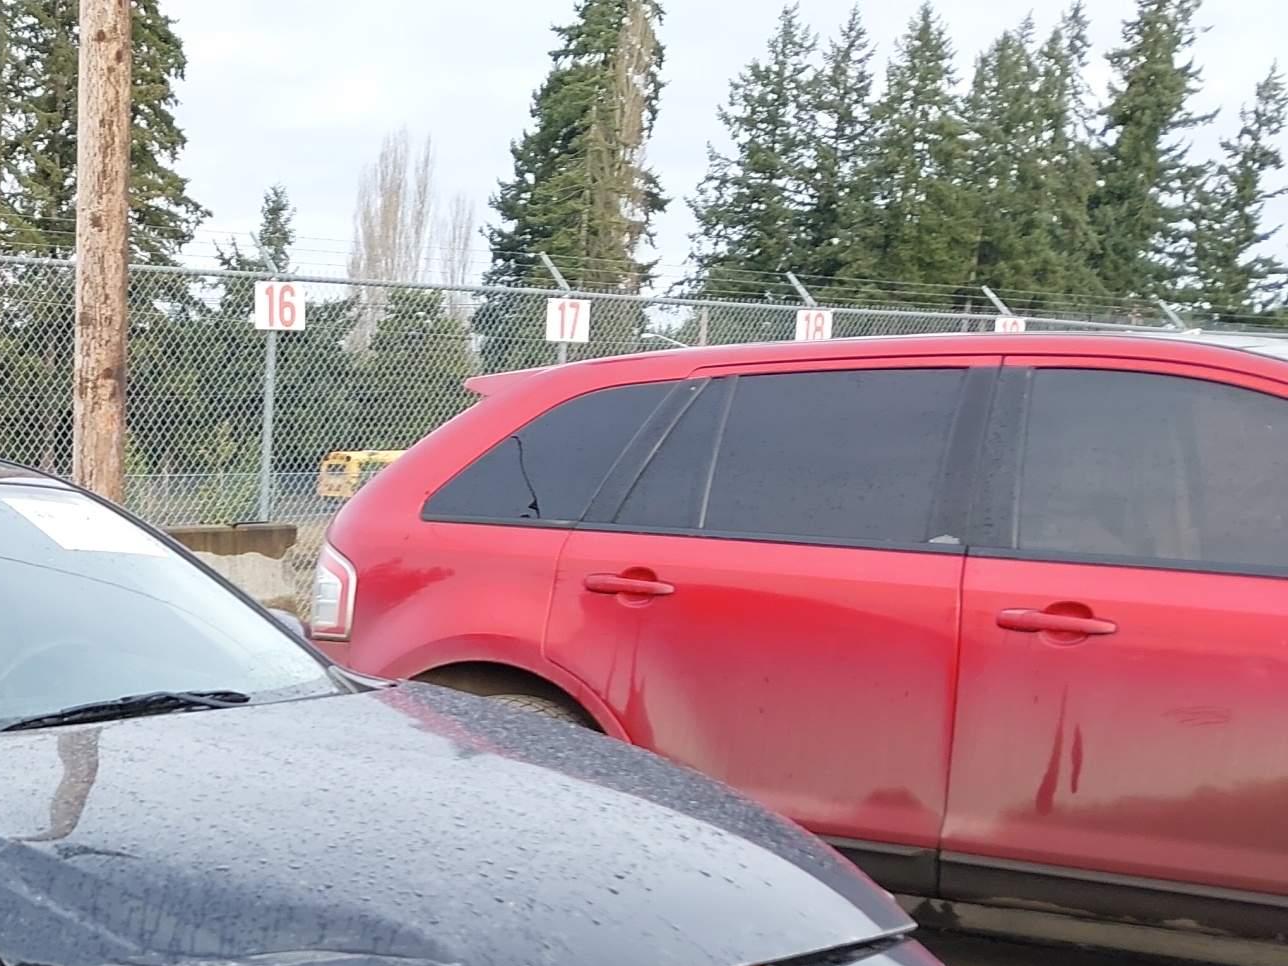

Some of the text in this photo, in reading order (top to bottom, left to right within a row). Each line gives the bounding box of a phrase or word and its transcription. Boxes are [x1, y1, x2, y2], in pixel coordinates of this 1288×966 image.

[266, 286, 296, 328] 16
[559, 303, 580, 335] 17
[804, 313, 825, 340] 18
